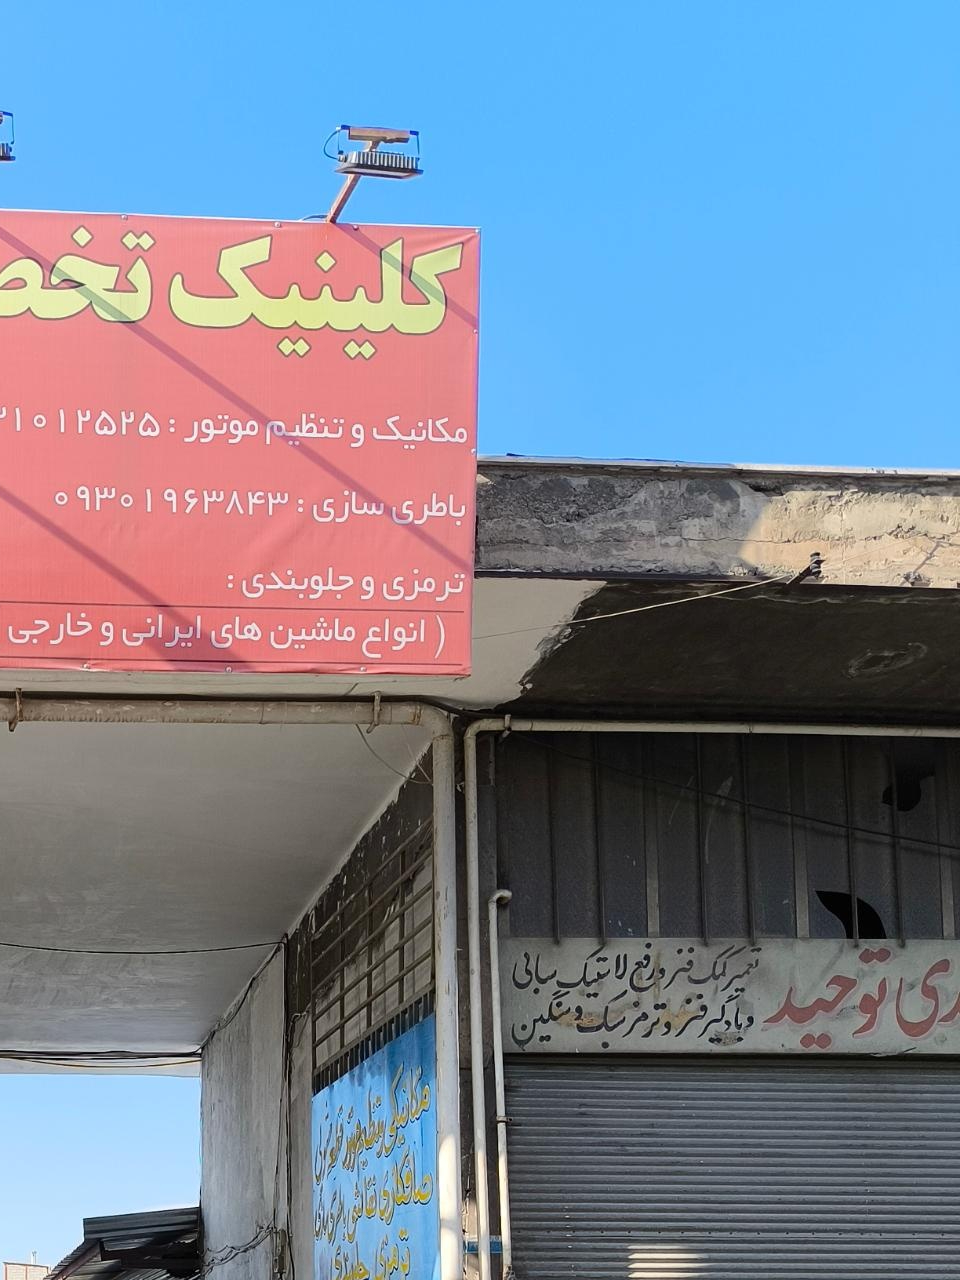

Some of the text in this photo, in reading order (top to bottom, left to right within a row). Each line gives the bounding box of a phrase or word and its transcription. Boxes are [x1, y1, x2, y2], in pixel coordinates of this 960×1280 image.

[169, 234, 464, 360] کلینیک
[265, 413, 344, 447] تنظیم
[350, 424, 365, 447] و
[372, 416, 468, 449] مکانیک
[54, 484, 290, 518] ۰۹۳۰۱۹۶۳۸۴۳
[392, 491, 467, 527] باطری
[360, 577, 375, 599] و
[388, 572, 465, 604] ترمزی
[99, 623, 113, 647] و
[122, 613, 202, 649] ایرانی
[210, 616, 263, 649] های
[269, 616, 357, 651] ماشین
[661, 946, 695, 991] فنر
[687, 944, 747, 985] کمک
[720, 946, 763, 993] تعمیر
[674, 992, 709, 1039] فنر
[761, 947, 892, 1050] توحید
[511, 989, 571, 1050] سنگین
[575, 988, 628, 1049] سبک
[622, 999, 668, 1039] ترمز
